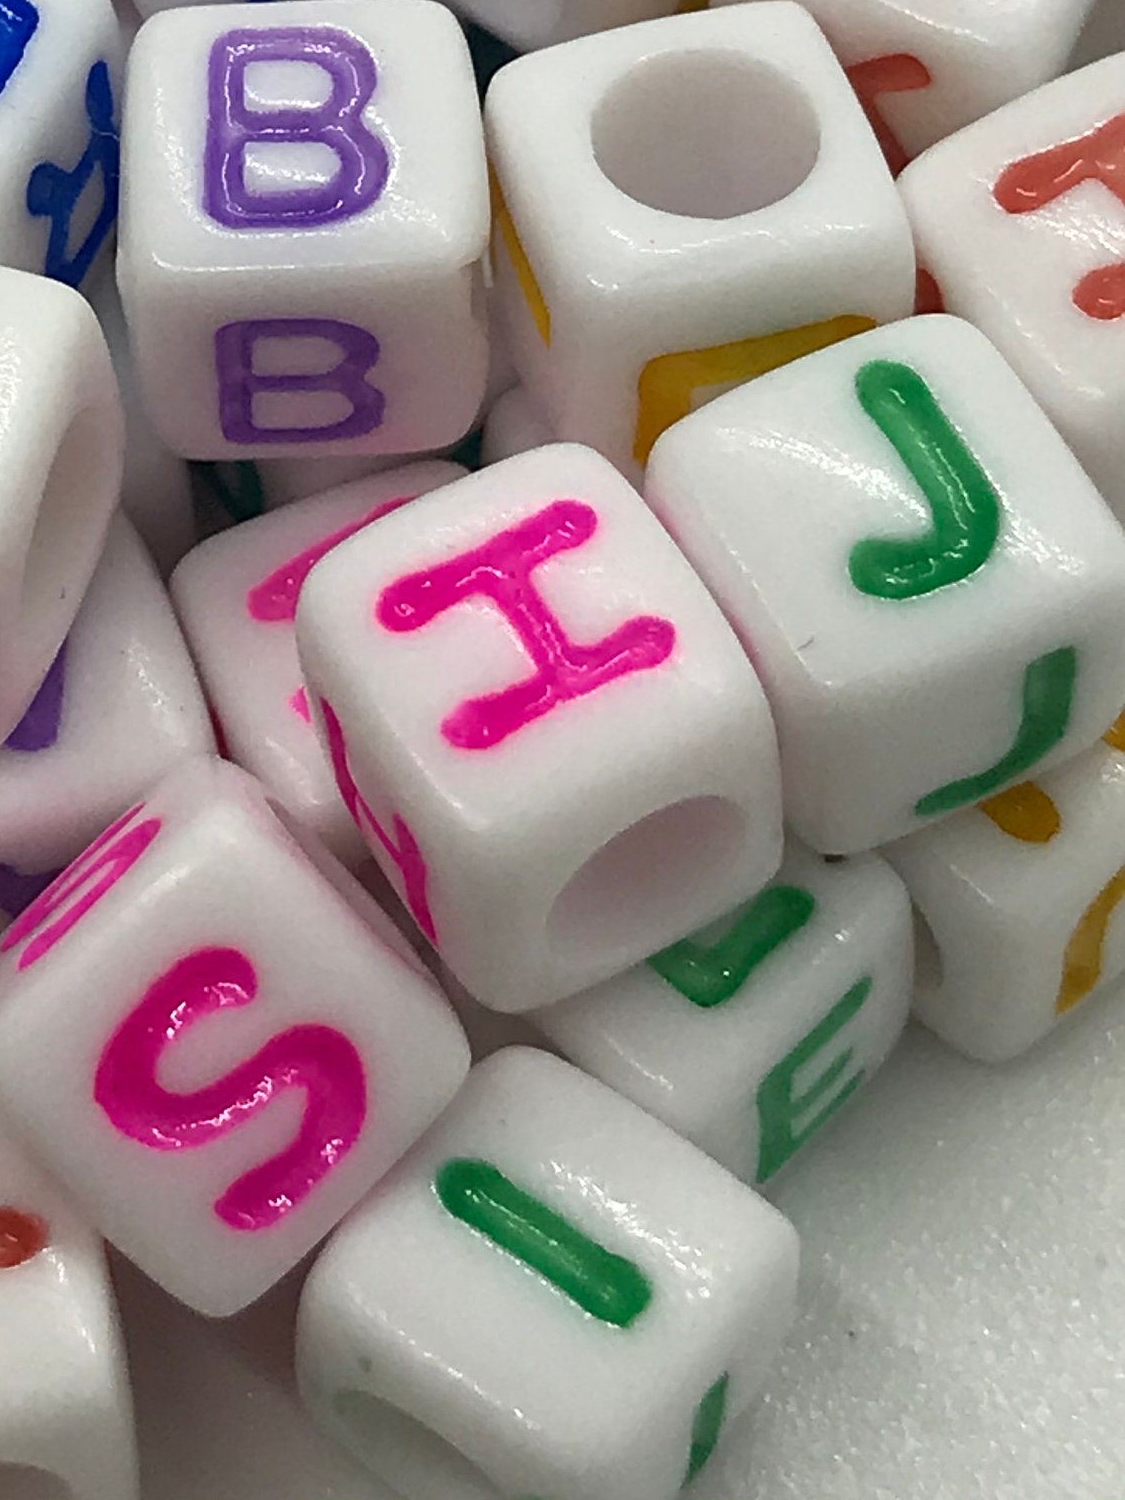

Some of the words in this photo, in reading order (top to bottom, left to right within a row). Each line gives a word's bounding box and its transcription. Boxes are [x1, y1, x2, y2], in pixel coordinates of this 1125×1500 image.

[202, 27, 389, 230] B
[215, 318, 385, 445] B
[848, 360, 1001, 601] J
[375, 500, 676, 750] H
[914, 645, 1077, 817] J
[91, 946, 368, 1232] S
[755, 974, 873, 1184] E
[435, 1157, 653, 1330] I
